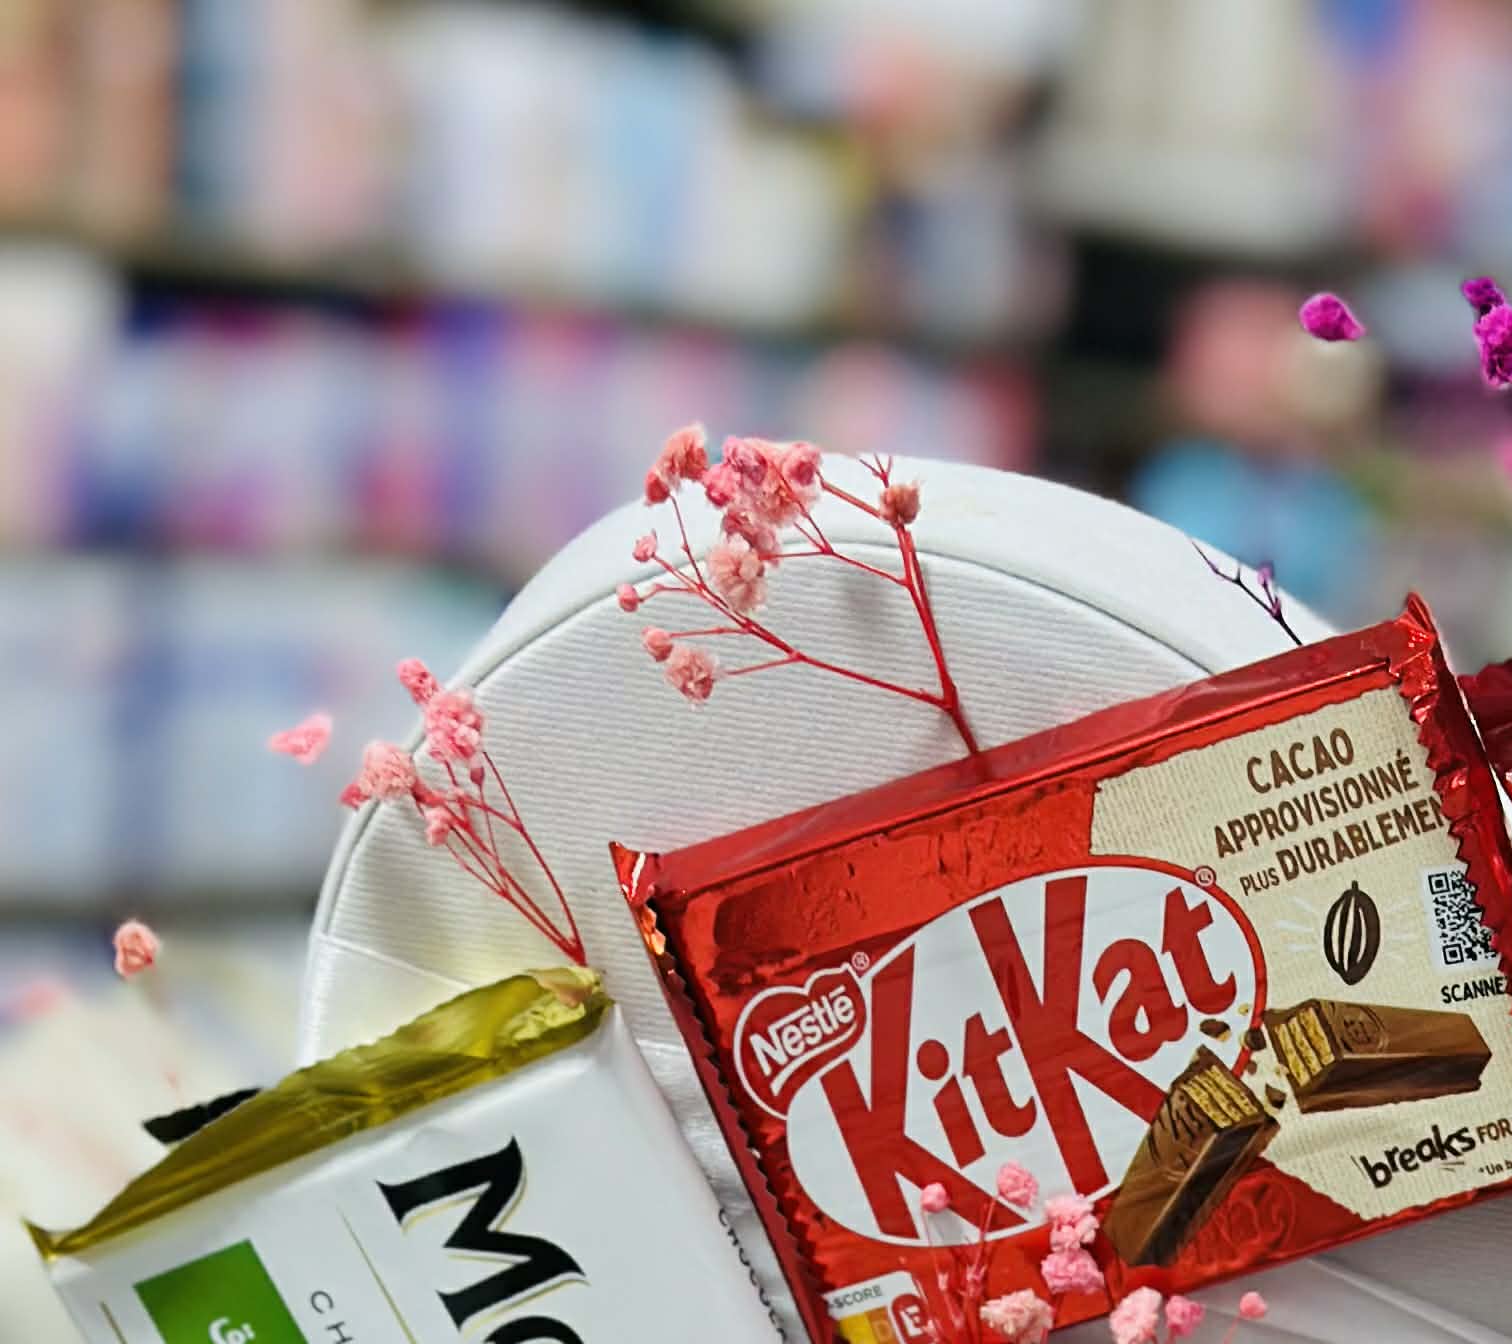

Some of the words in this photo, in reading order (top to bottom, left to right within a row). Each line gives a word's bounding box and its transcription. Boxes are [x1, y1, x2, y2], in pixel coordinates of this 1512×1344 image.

[1247, 728, 1354, 794] CACAO
[1214, 749, 1420, 859] APPROVISIONNÉ
[1240, 867, 1281, 896] PLUS
[1441, 976, 1508, 1004] SCANNE
[820, 877, 1237, 1241] KitKat
[1361, 1124, 1477, 1189] breaks
[1476, 1118, 1512, 1144] FOR
